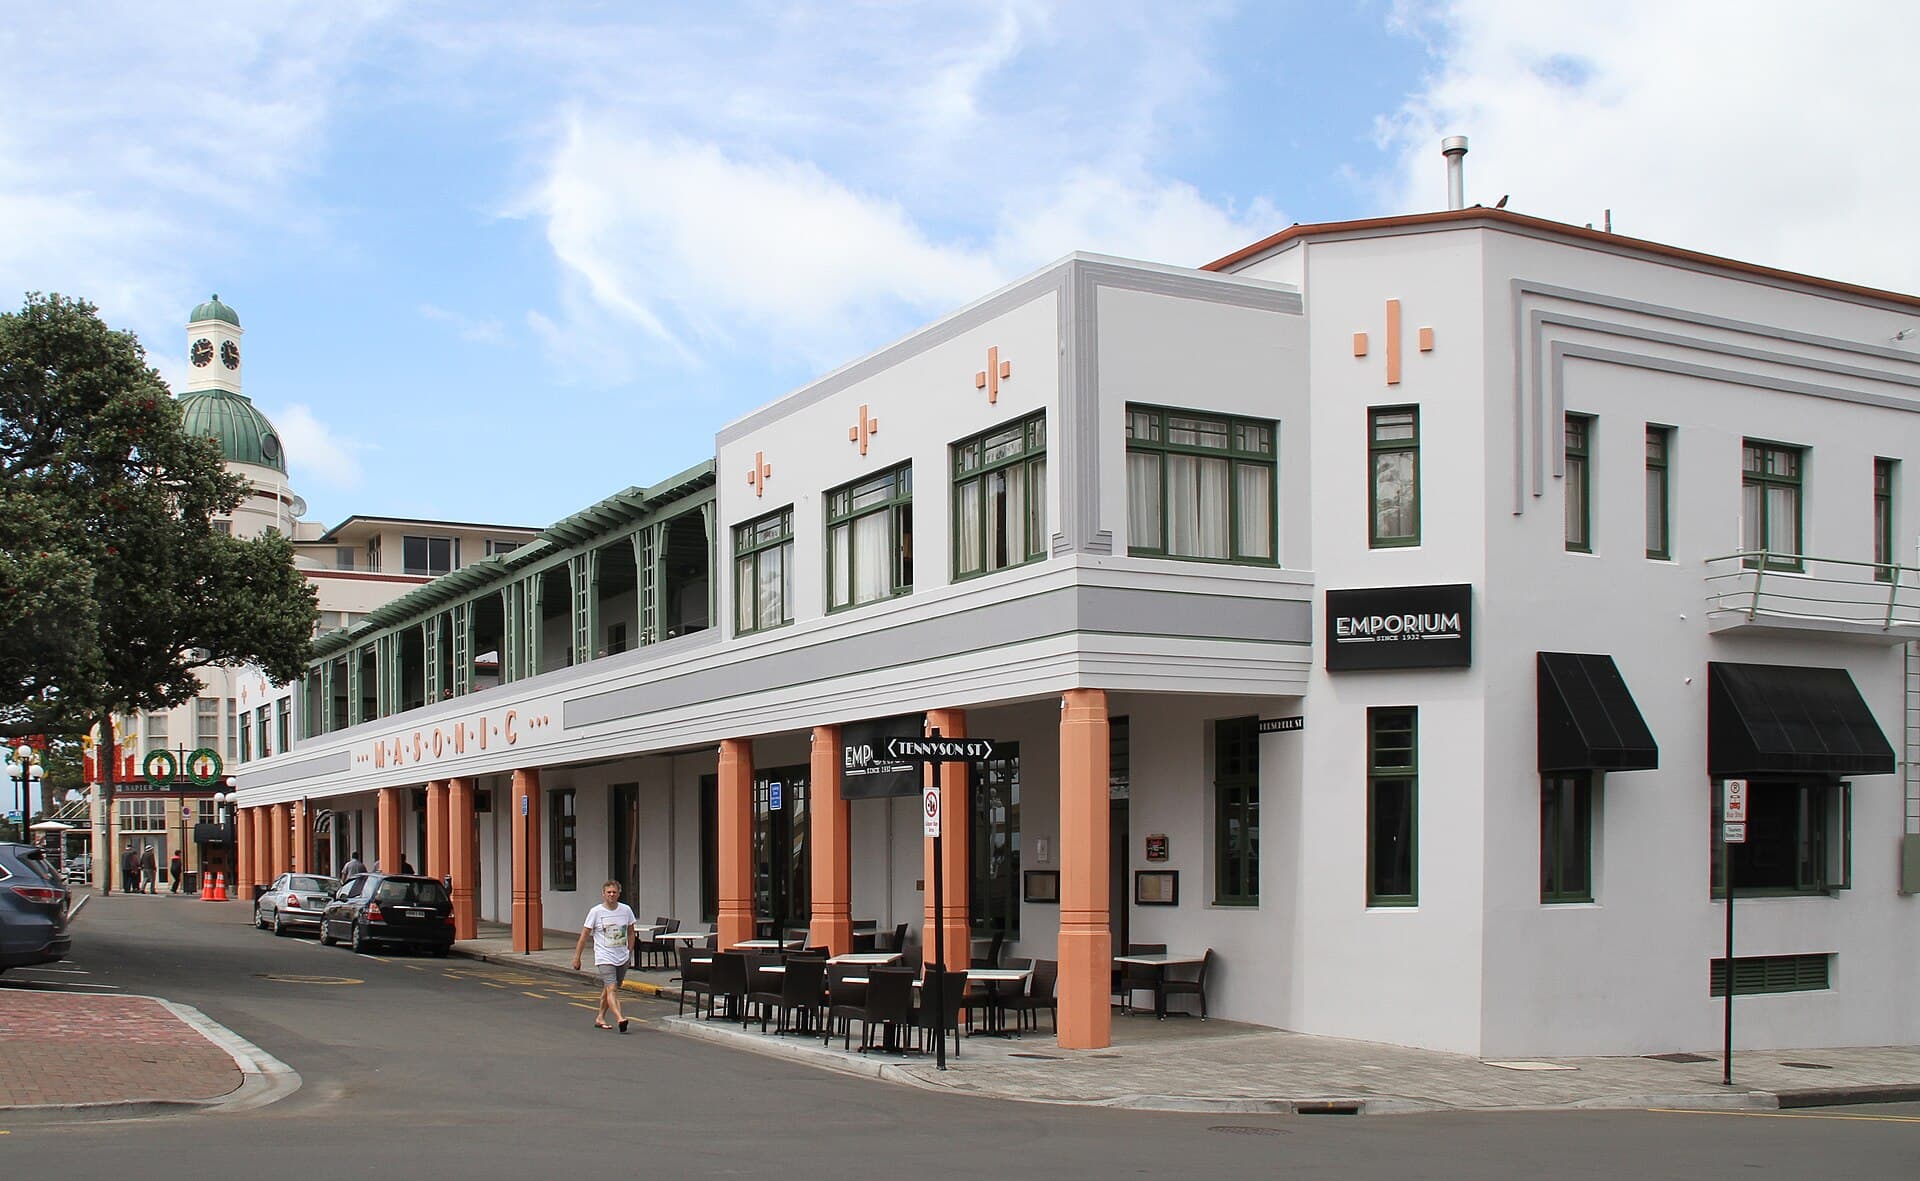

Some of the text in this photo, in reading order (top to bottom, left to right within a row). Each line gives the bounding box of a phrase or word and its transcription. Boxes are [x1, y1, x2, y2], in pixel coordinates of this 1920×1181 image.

[1336, 613, 1461, 636] EMPORIUM
[1402, 633, 1420, 641] 1932
[897, 741, 964, 756] TENNYSON
[966, 743, 983, 756] ST
